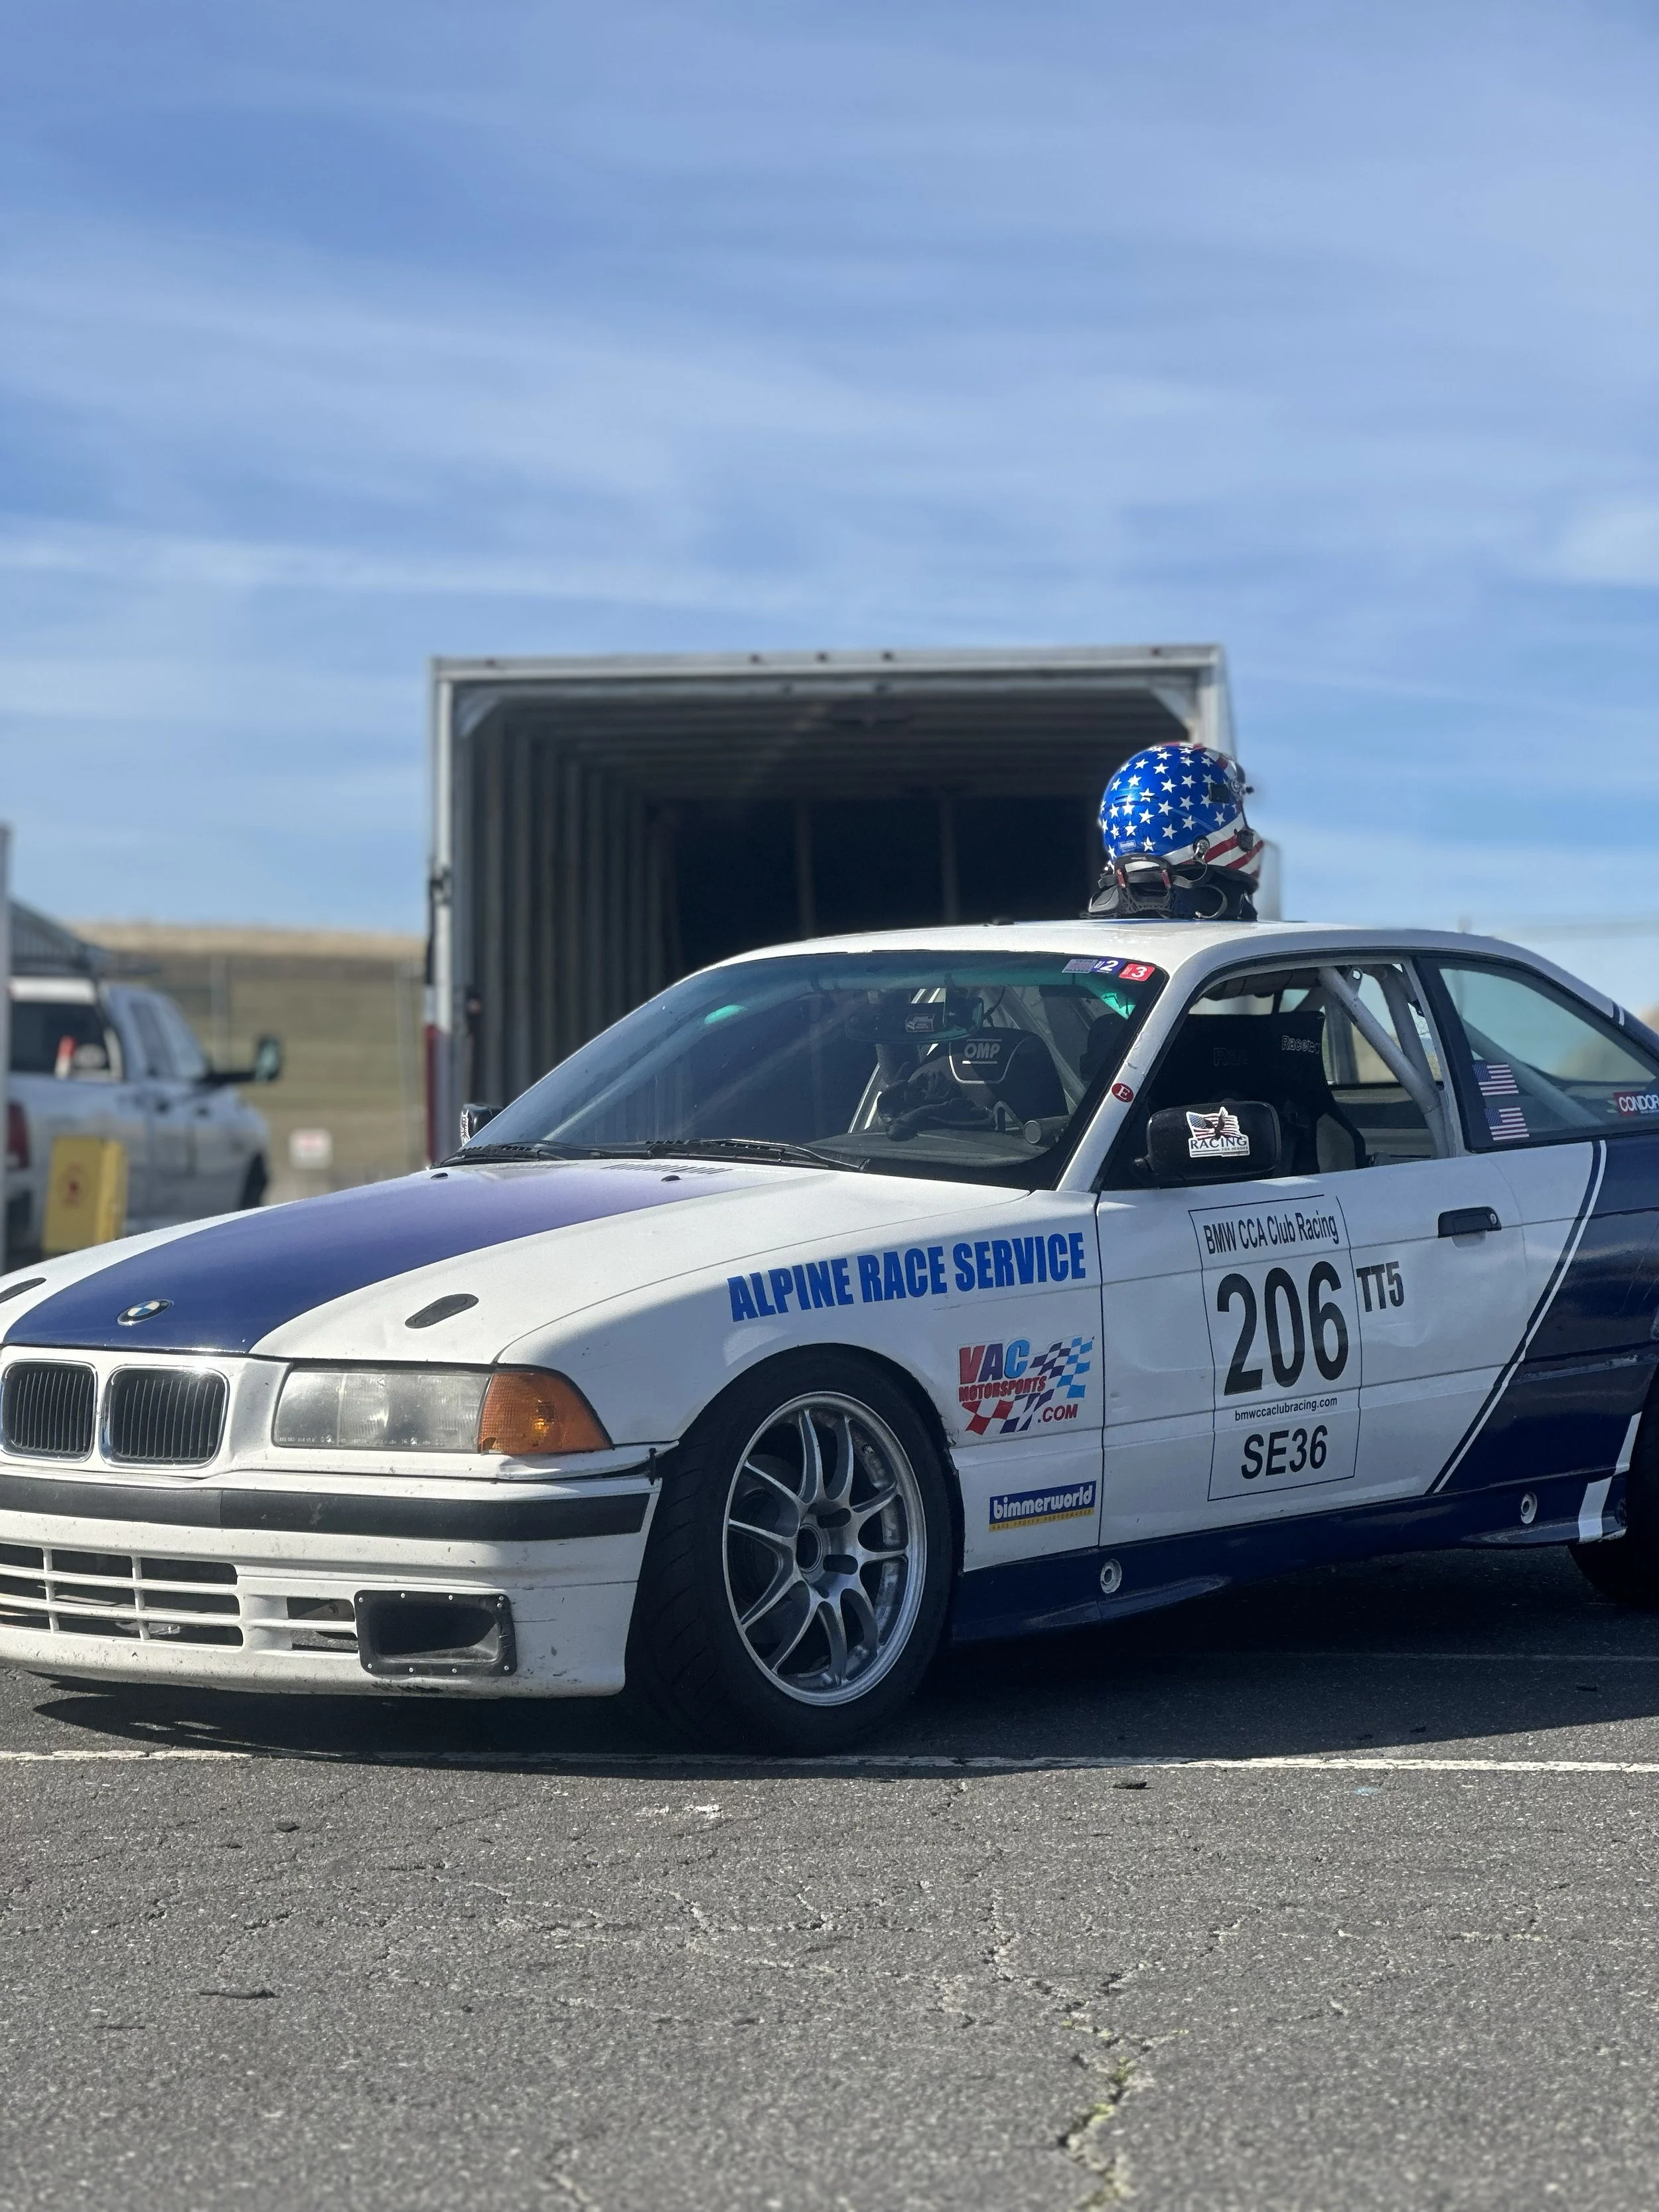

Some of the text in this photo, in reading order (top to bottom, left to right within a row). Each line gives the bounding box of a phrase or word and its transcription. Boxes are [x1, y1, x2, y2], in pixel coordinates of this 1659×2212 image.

[1100, 960, 1119, 972] 2
[1131, 966, 1148, 978] 3
[964, 1043, 1001, 1059] OMP
[1116, 1084, 1130, 1100] E
[1619, 1094, 1659, 1112] CONDOR
[1190, 1136, 1247, 1149] RACING
[1203, 1210, 1339, 1254] BMW CCA Club Racing
[727, 1232, 1086, 1322] ALPINE RACE SERVICE
[1356, 1261, 1405, 1313] TT5
[1216, 1260, 1348, 1396] 206
[959, 1339, 1030, 1385] VAC
[958, 1376, 1047, 1402] MOTORSPORTS
[1234, 1396, 1338, 1421] bmwccaclubracing.com
[1241, 1424, 1328, 1479] SE36
[993, 1485, 1093, 1519] bimmerworld
